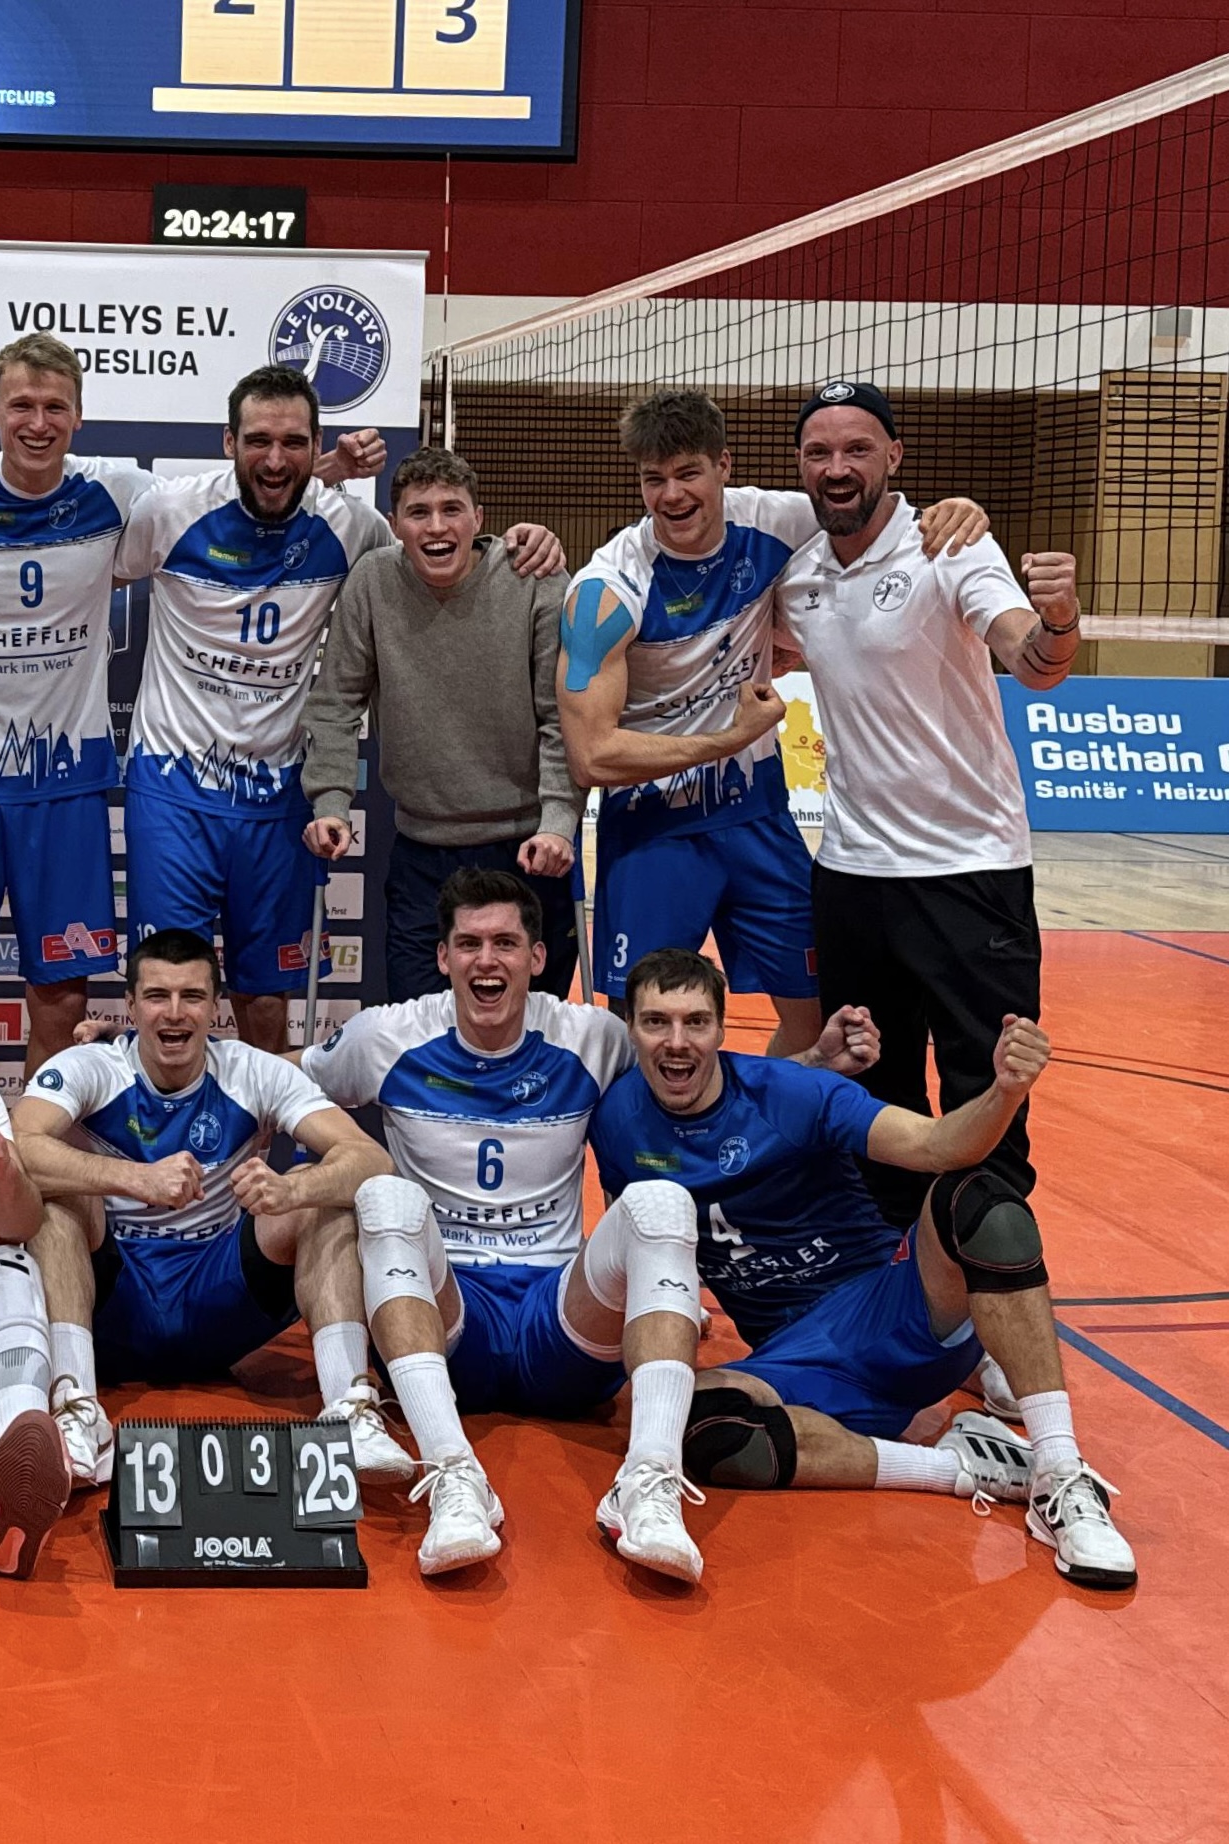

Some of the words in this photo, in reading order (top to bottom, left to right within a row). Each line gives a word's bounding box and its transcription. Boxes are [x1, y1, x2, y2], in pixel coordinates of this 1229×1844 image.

[163, 208, 296, 240] 20:24:17
[8, 301, 162, 336] VOLLEYS
[176, 306, 236, 338] E.V.
[277, 312, 307, 346] L.E.
[303, 293, 382, 345] VOLLEYS
[76, 348, 199, 376] DESLIGA
[20, 560, 44, 609] 9
[236, 601, 281, 645] 10
[22, 659, 40, 674] im
[43, 655, 74, 671] Werk
[185, 645, 303, 679] SCHEFFLER
[197, 679, 231, 697] stark
[234, 686, 249, 701] im
[1026, 702, 1182, 735] Ausbau
[1030, 740, 1205, 773] Geithain
[1034, 779, 1127, 799] Sanitär
[41, 921, 118, 963] EAD
[613, 933, 629, 968] 3
[477, 1138, 505, 1192] 6
[440, 1228, 474, 1245] stark
[478, 1231, 498, 1246] im
[502, 1230, 542, 1247] Werk
[709, 1202, 758, 1261] 4
[125, 1441, 177, 1514] 13
[201, 1433, 224, 1487] 0
[250, 1434, 272, 1486] 3
[299, 1441, 358, 1514] 25
[194, 1536, 273, 1558] JOOLA
